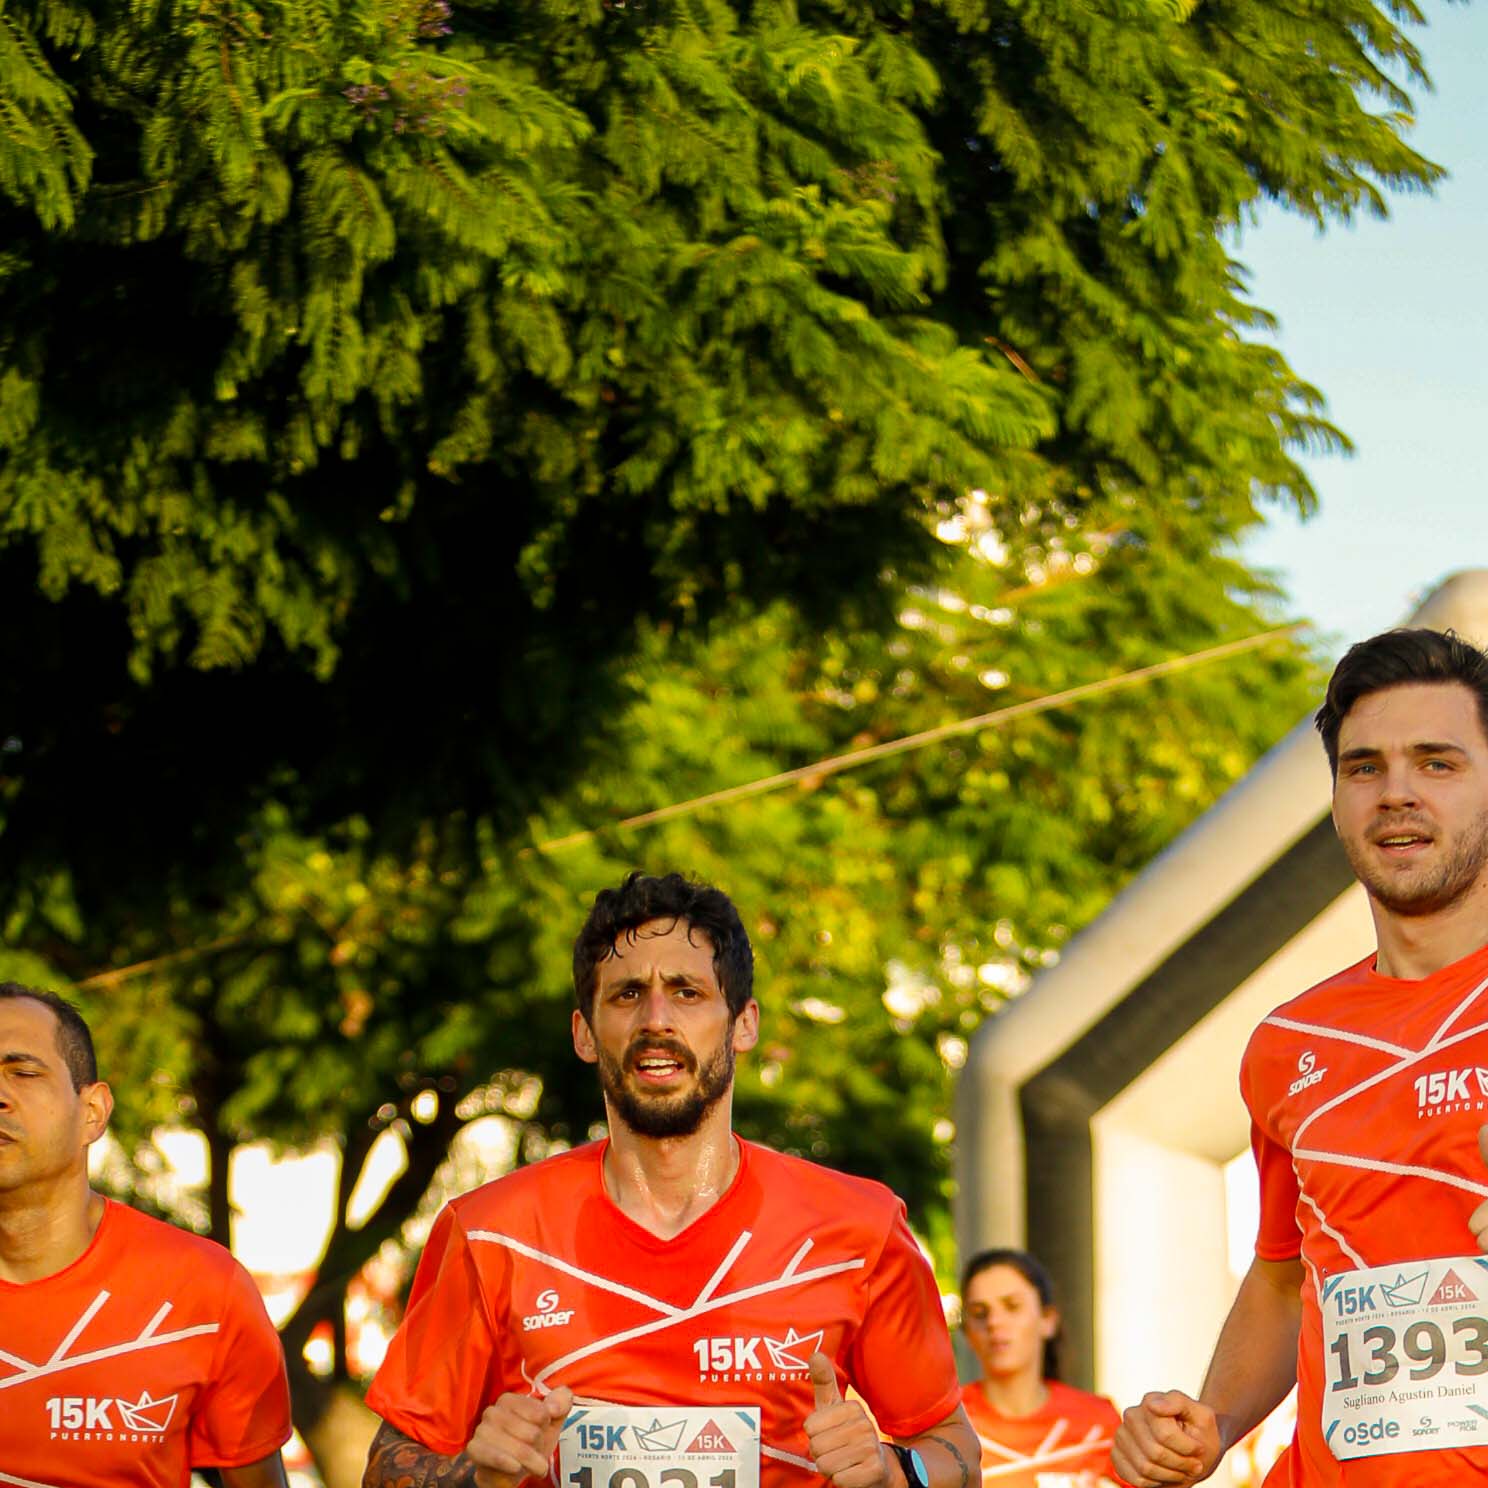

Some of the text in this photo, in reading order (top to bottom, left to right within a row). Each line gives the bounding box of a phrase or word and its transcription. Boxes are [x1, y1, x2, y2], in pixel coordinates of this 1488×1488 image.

[1414, 1068, 1473, 1107] 15K
[1418, 1102, 1471, 1119] PUERTO
[1334, 1284, 1466, 1316] 15K 15K
[693, 1337, 762, 1371] 15K
[700, 1373, 762, 1383] PUERTO
[1343, 1393, 1385, 1410] Sugliano
[1438, 1383, 1476, 1398] Daniel
[45, 1397, 113, 1430] 15K
[50, 1432, 165, 1443] PUERTO NORTE
[576, 1424, 725, 1451] 15K 15K
